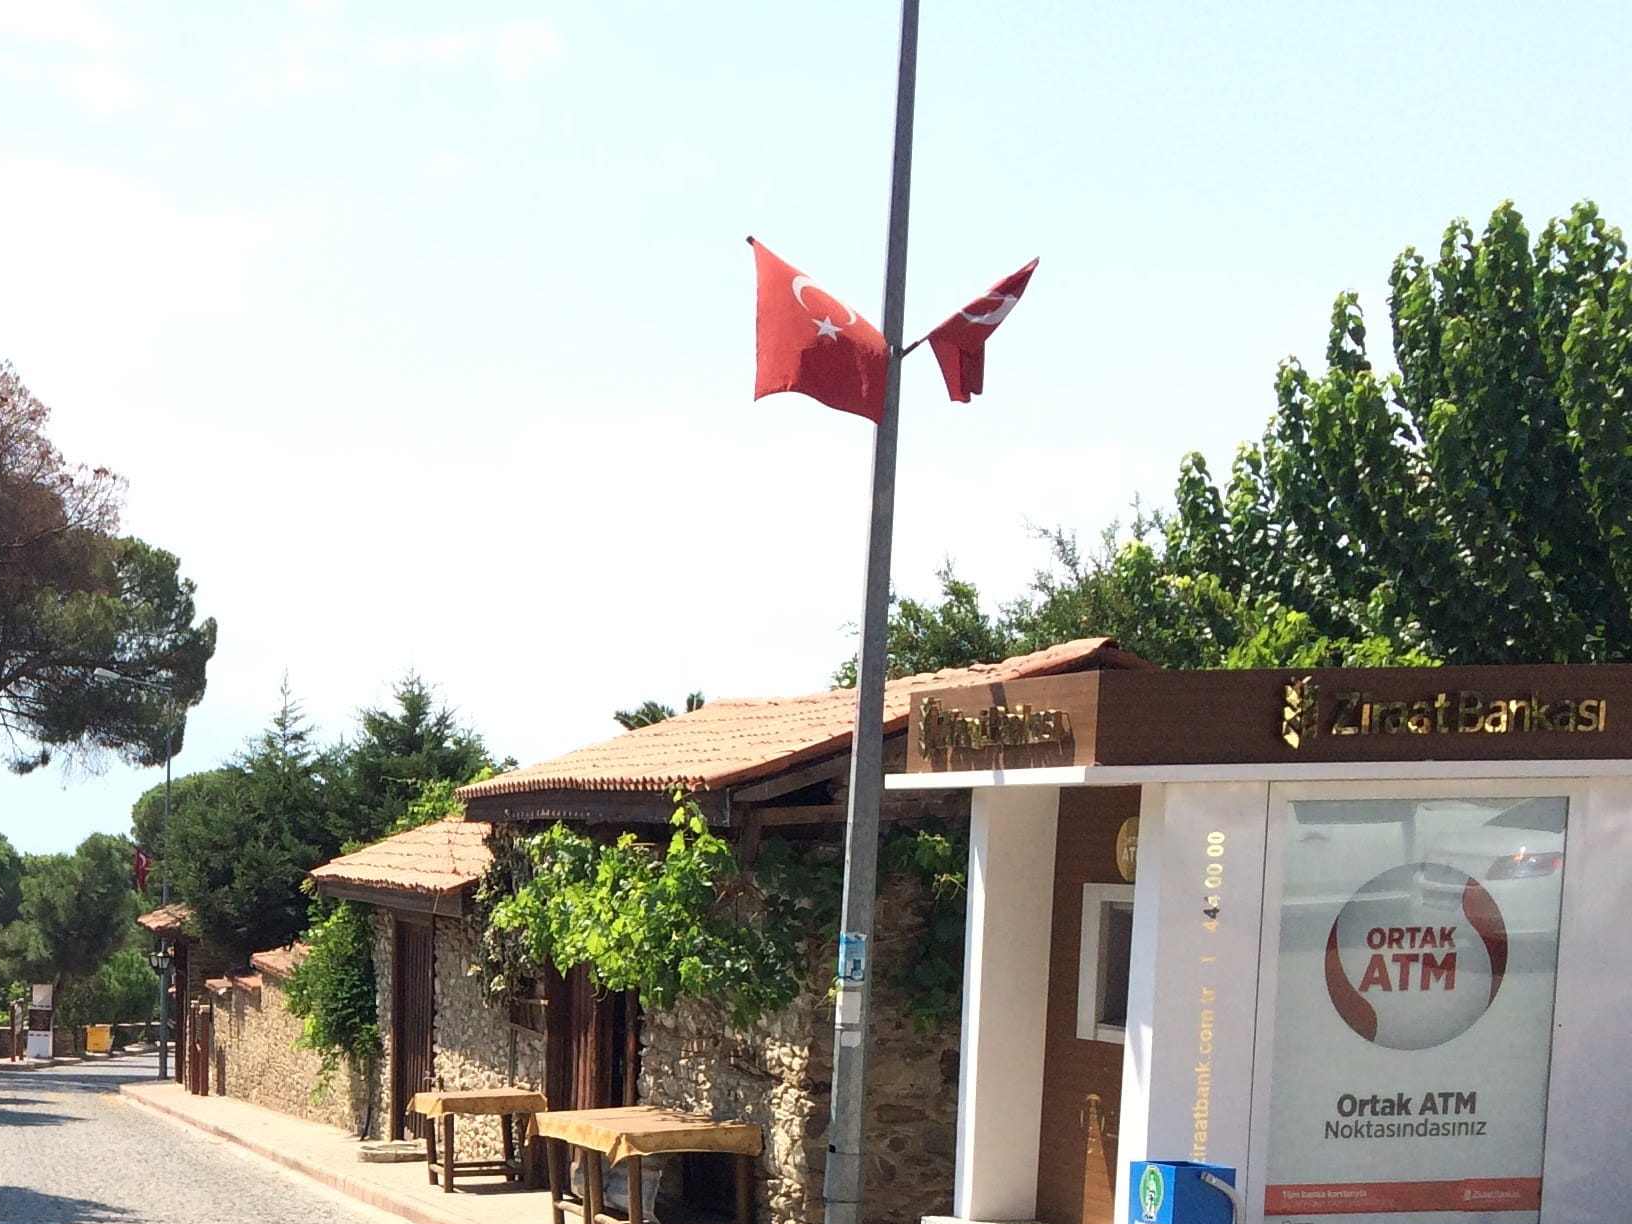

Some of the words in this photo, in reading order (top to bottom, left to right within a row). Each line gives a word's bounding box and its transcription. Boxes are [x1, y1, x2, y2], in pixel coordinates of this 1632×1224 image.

[1458, 689, 1608, 734] Bankası
[1122, 847, 1137, 863] AT
[1206, 831, 1225, 857] 00
[1204, 863, 1223, 888] 00
[1203, 895, 1220, 932] 444
[1366, 926, 1456, 949] ORTAK
[1359, 952, 1457, 991] ATM
[1337, 1093, 1412, 1117] Ortak
[1419, 1091, 1477, 1115] ATM
[1325, 1118, 1487, 1139] Noktasındasınız
